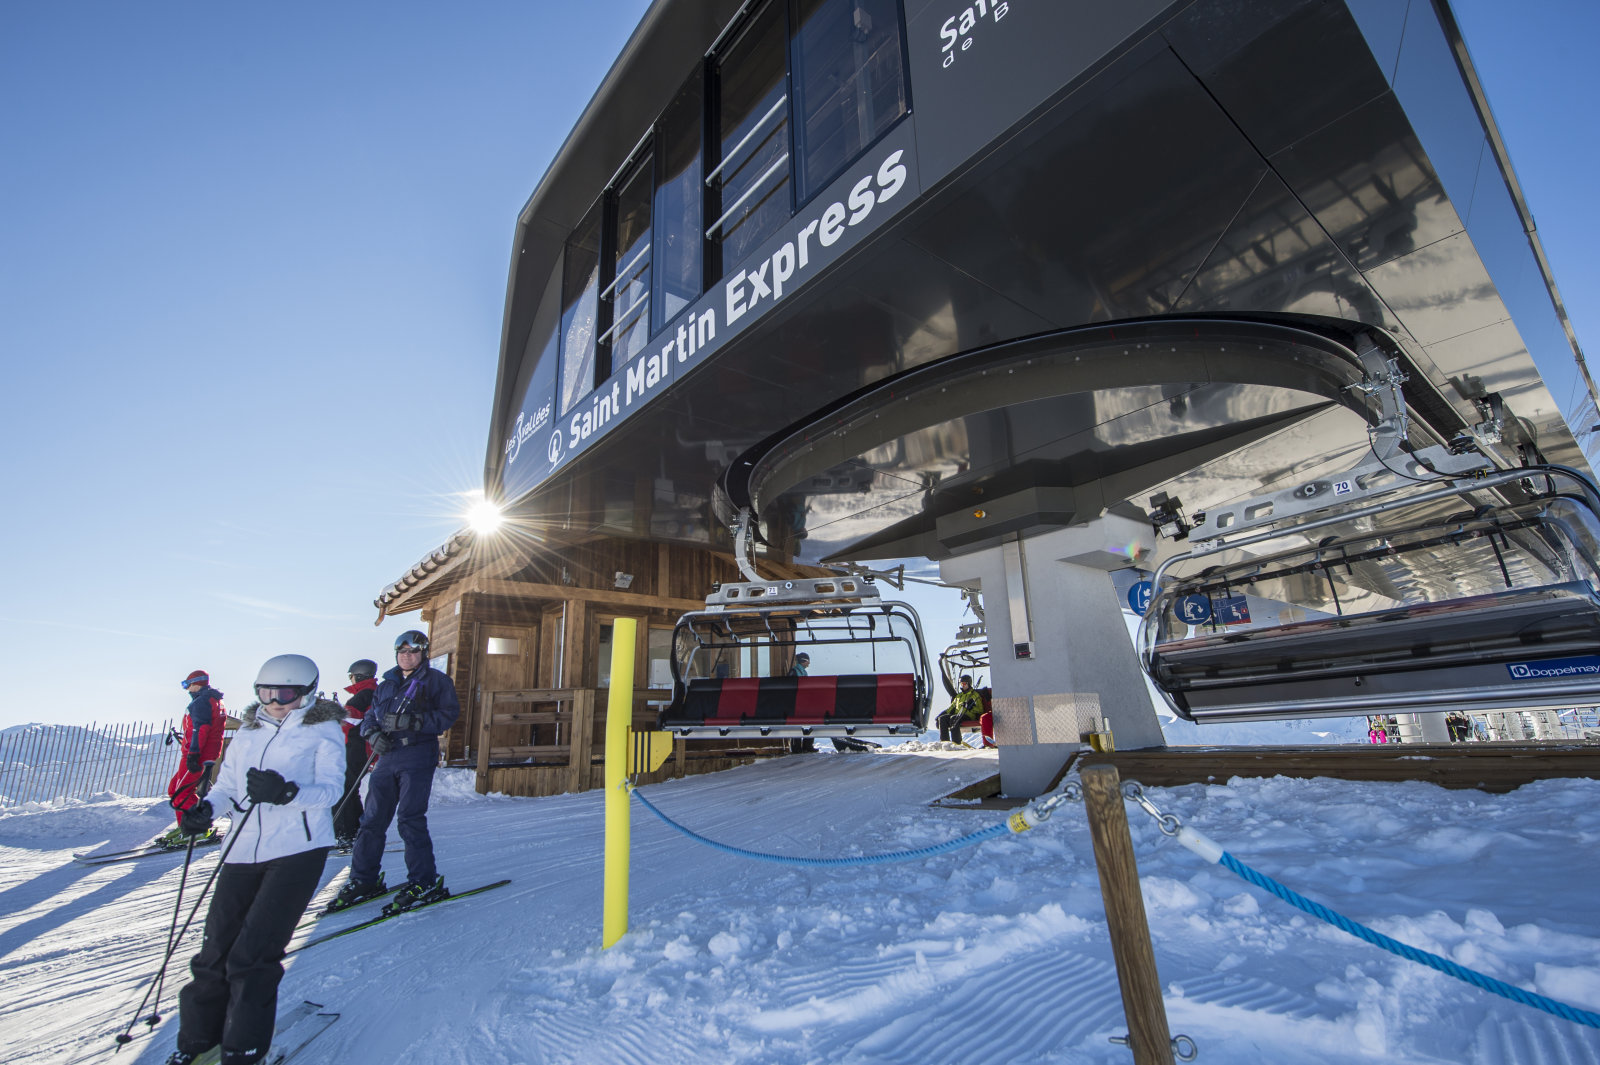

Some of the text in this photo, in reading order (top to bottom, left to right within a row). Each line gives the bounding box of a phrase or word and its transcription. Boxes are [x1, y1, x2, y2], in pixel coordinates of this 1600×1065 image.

[942, 37, 973, 68] de
[569, 149, 907, 449] Saint Martin Express
[505, 435, 517, 455] Les
[1335, 482, 1348, 491] 70
[1530, 665, 1600, 677] Doppelmay
